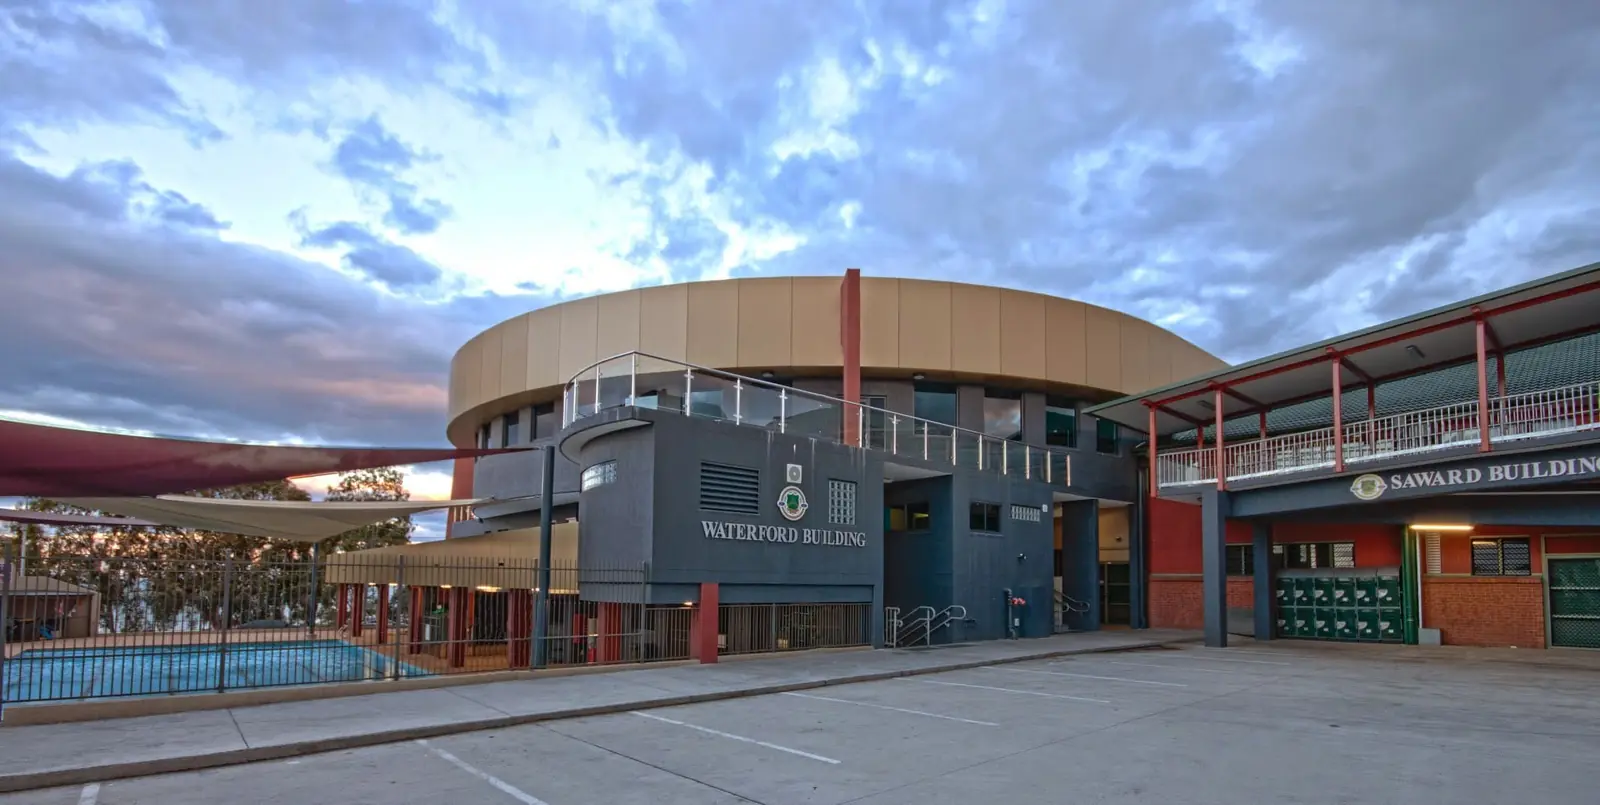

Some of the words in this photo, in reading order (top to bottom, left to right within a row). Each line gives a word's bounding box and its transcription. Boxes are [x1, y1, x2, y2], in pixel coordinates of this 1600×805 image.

[1391, 468, 1481, 489] SAWARD
[1488, 456, 1600, 481] BUILDIN
[702, 521, 798, 543] WATERFORD
[803, 529, 866, 547] BUILDING
